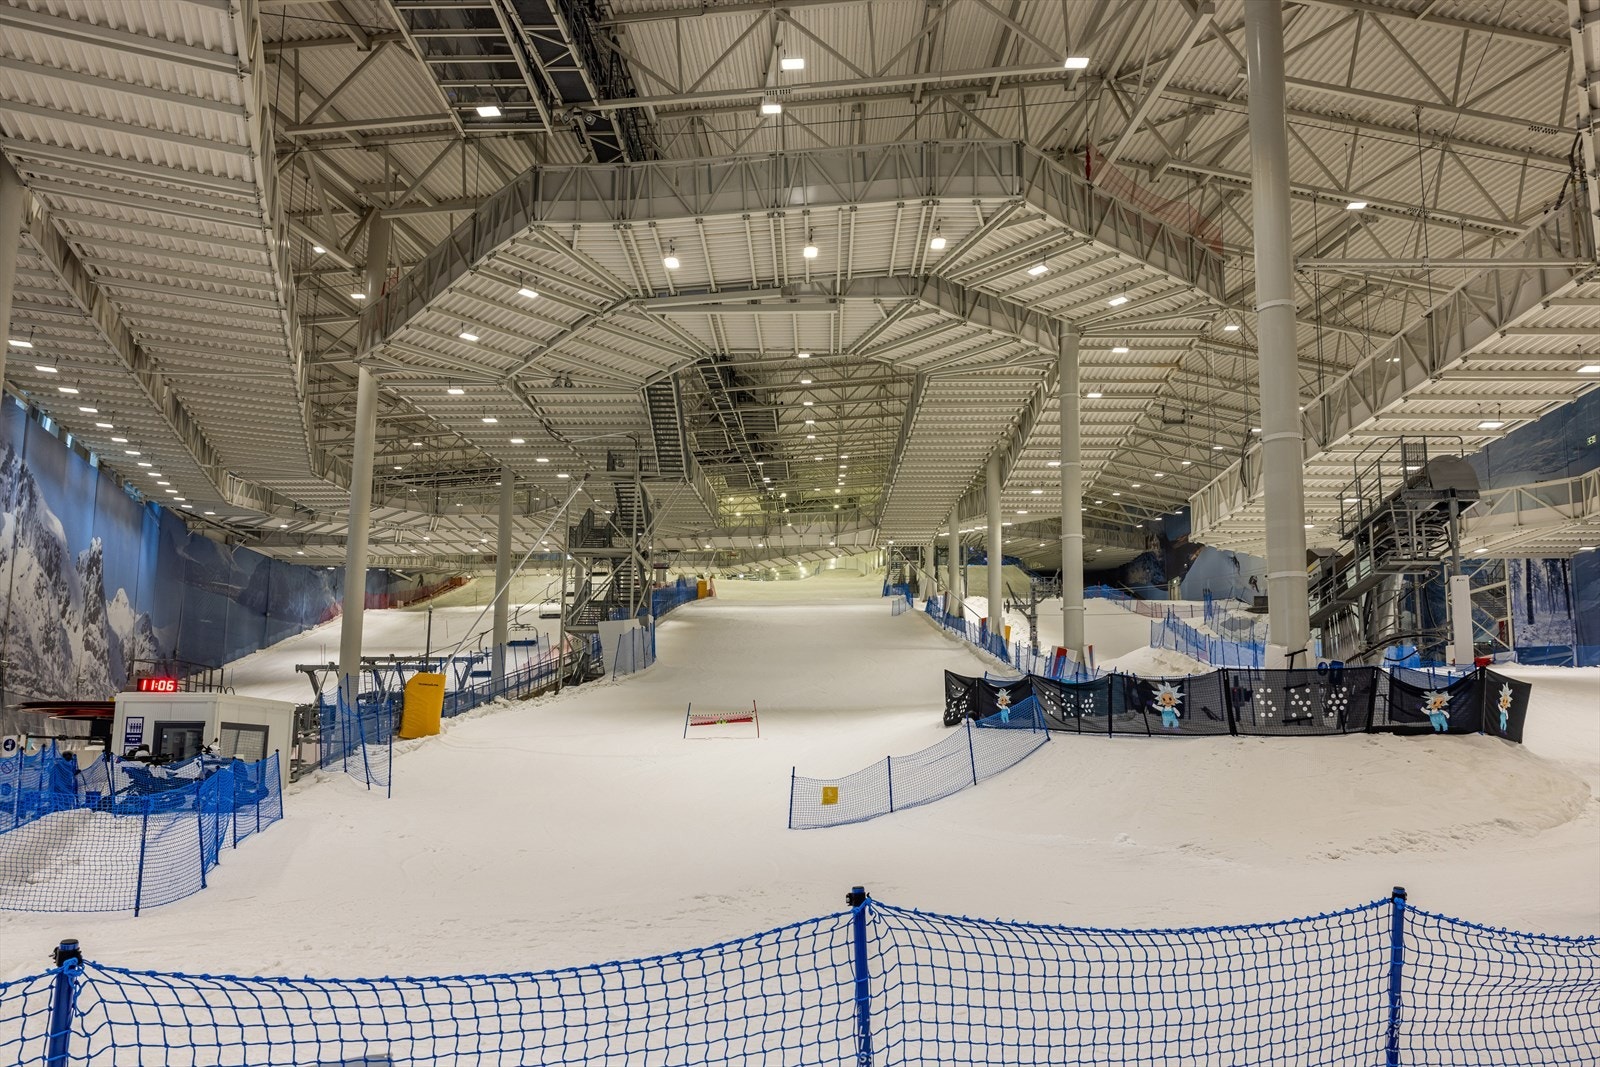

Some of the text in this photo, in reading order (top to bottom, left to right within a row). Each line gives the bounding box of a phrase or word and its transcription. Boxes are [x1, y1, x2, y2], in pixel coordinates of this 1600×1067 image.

[142, 679, 175, 691] 11:06
[1256, 687, 1348, 718] SNØ
[859, 1025, 867, 1067] LIS
